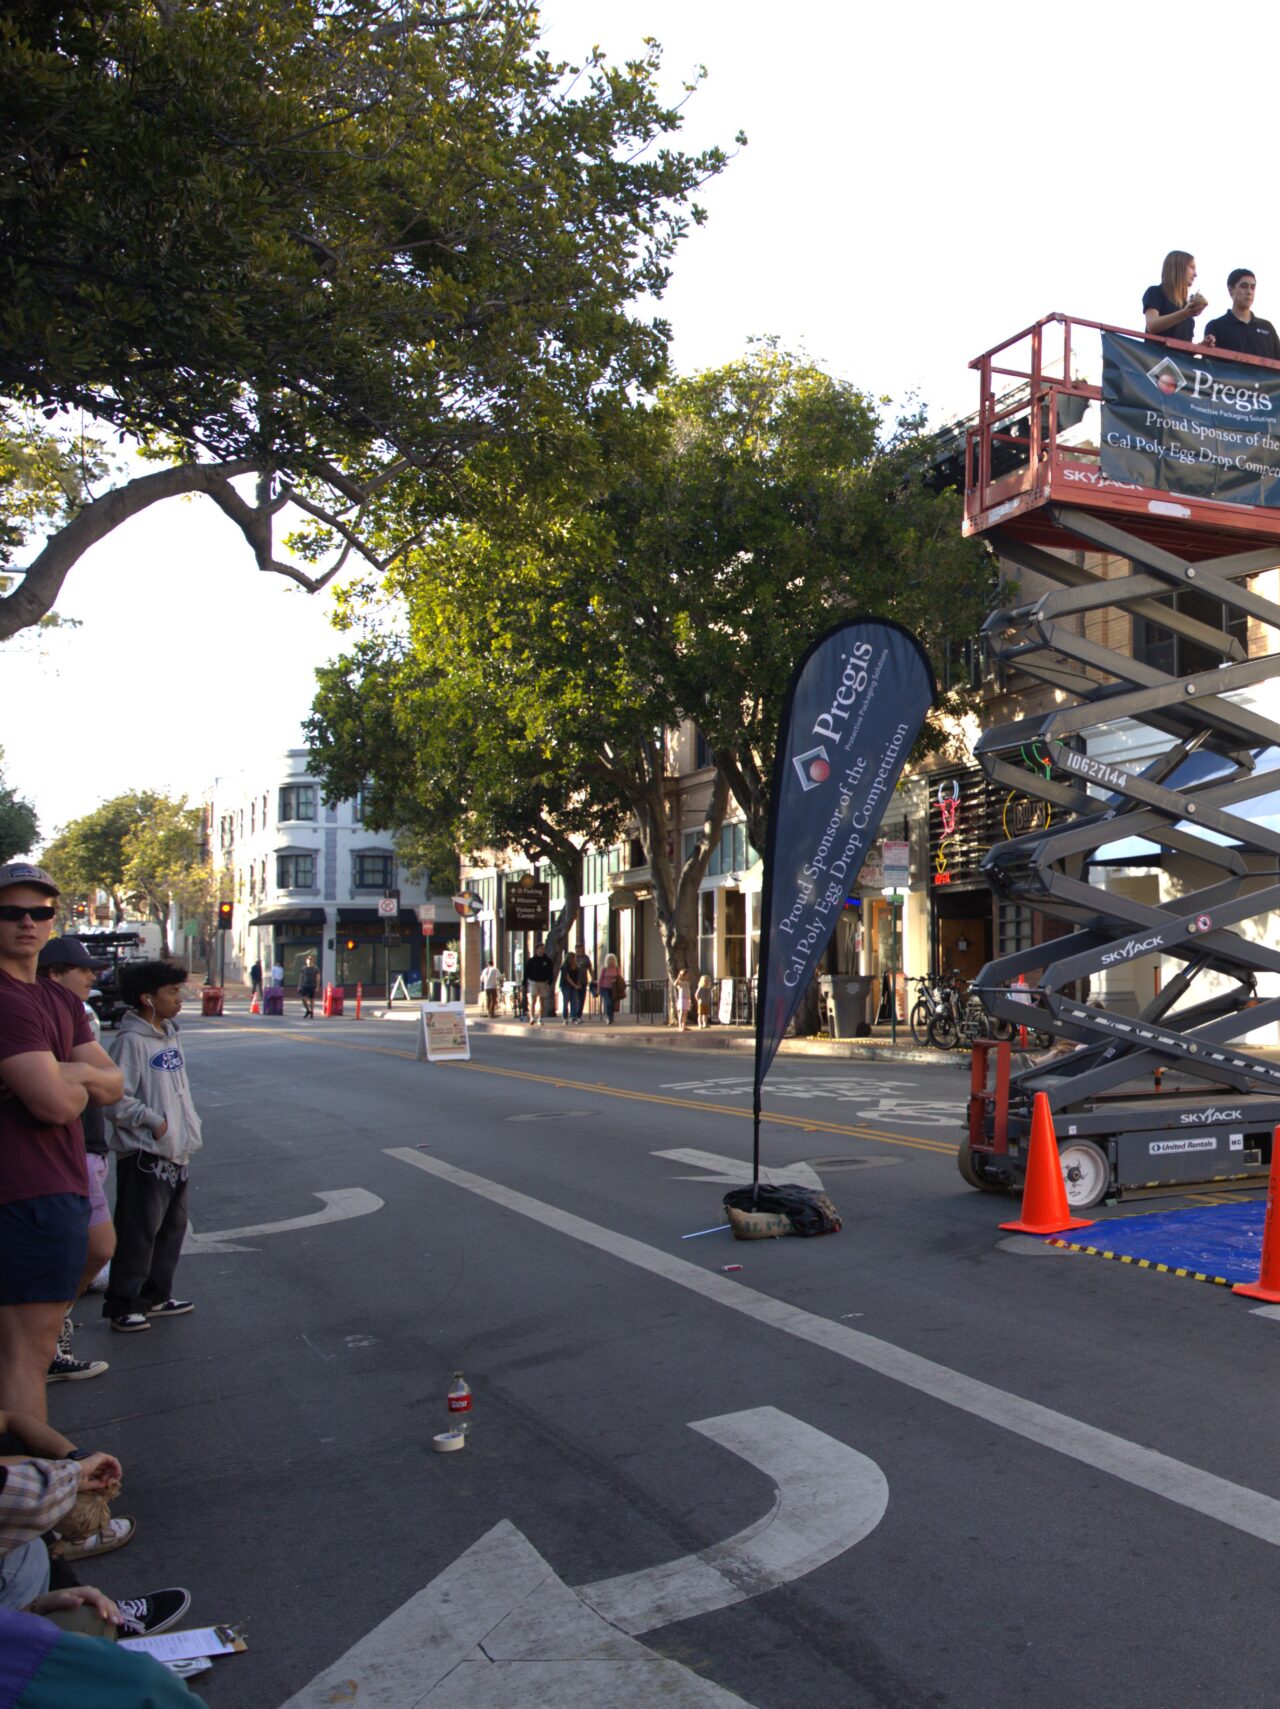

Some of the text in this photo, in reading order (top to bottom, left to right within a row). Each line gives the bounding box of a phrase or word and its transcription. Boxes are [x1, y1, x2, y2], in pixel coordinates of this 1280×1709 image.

[1191, 369, 1272, 412] Pregis
[1145, 411, 1280, 451] Proud Sponsor of the
[1190, 404, 1277, 424] Protective Packaging Solutions
[1107, 432, 1131, 448] Cal
[1136, 437, 1166, 460] Poly
[1169, 442, 1196, 465] Egg
[1199, 448, 1233, 470] Drop
[812, 641, 873, 744] Pregis
[844, 648, 889, 751] Protective Packaging Solutions
[1067, 752, 1127, 788] 10627144
[779, 757, 867, 935] Proud Sponsor of the
[783, 956, 806, 987] Cal
[796, 917, 826, 955] Poly
[814, 881, 843, 914] Egg
[829, 833, 863, 879] Drop
[852, 722, 909, 829] Competition
[1101, 935, 1164, 965] SKYJACK
[1180, 1107, 1242, 1123] SKYJACK
[1162, 1140, 1213, 1152] United Rentals
